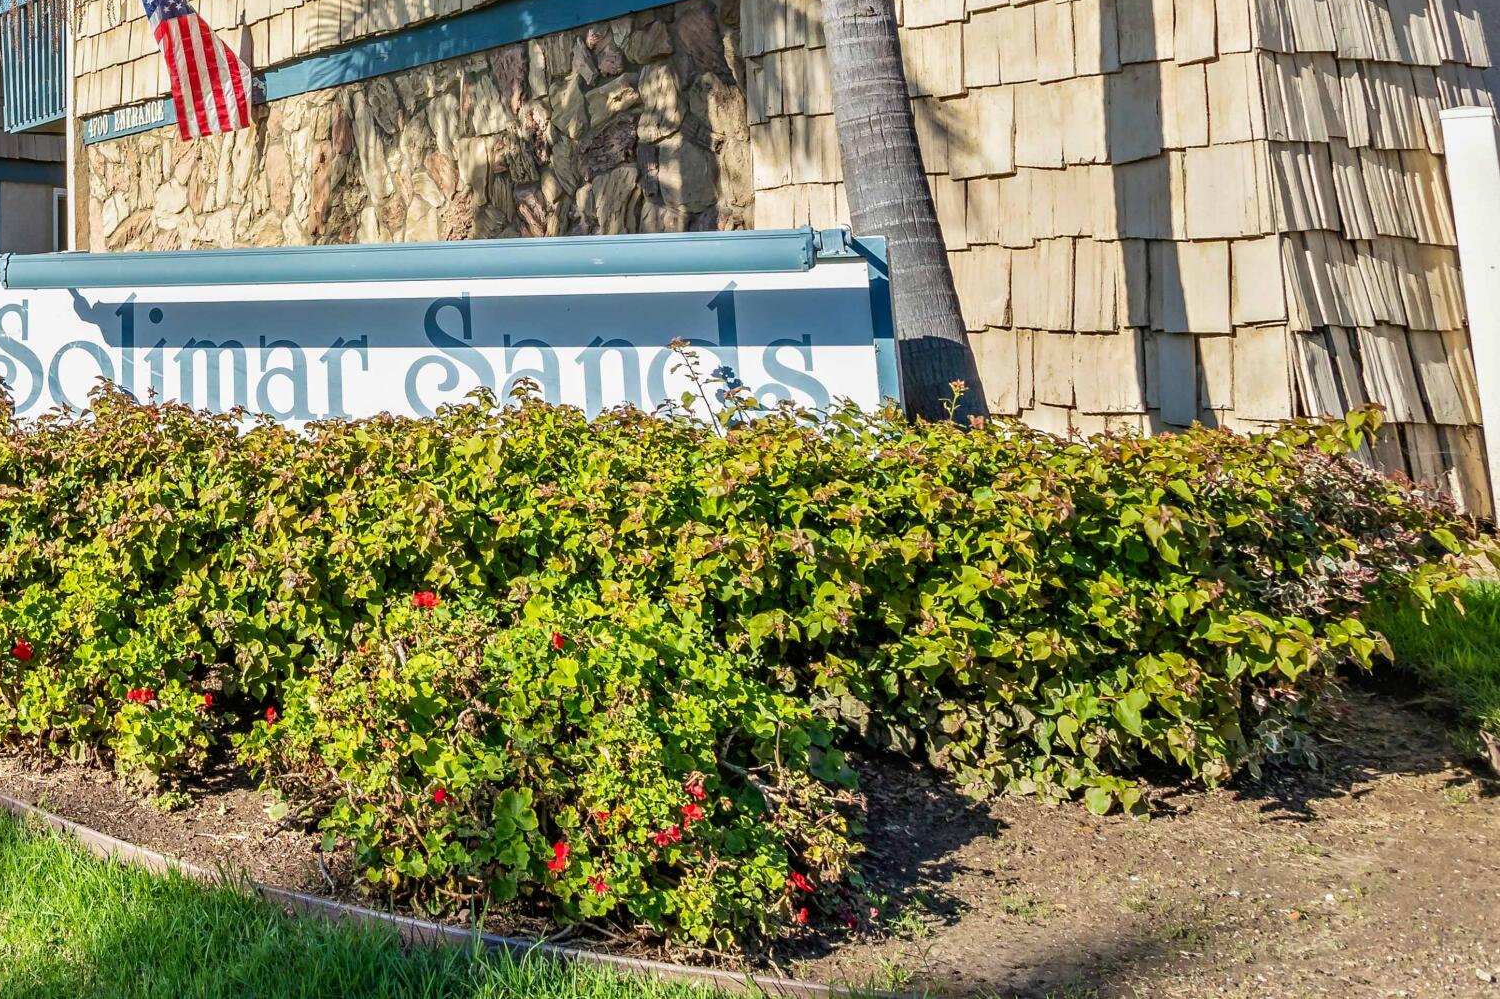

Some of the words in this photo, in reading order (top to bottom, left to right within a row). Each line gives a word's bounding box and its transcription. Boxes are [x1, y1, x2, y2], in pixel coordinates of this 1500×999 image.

[88, 114, 109, 138] 4700
[114, 100, 164, 132] ENTRANCE
[404, 281, 829, 424] Sands
